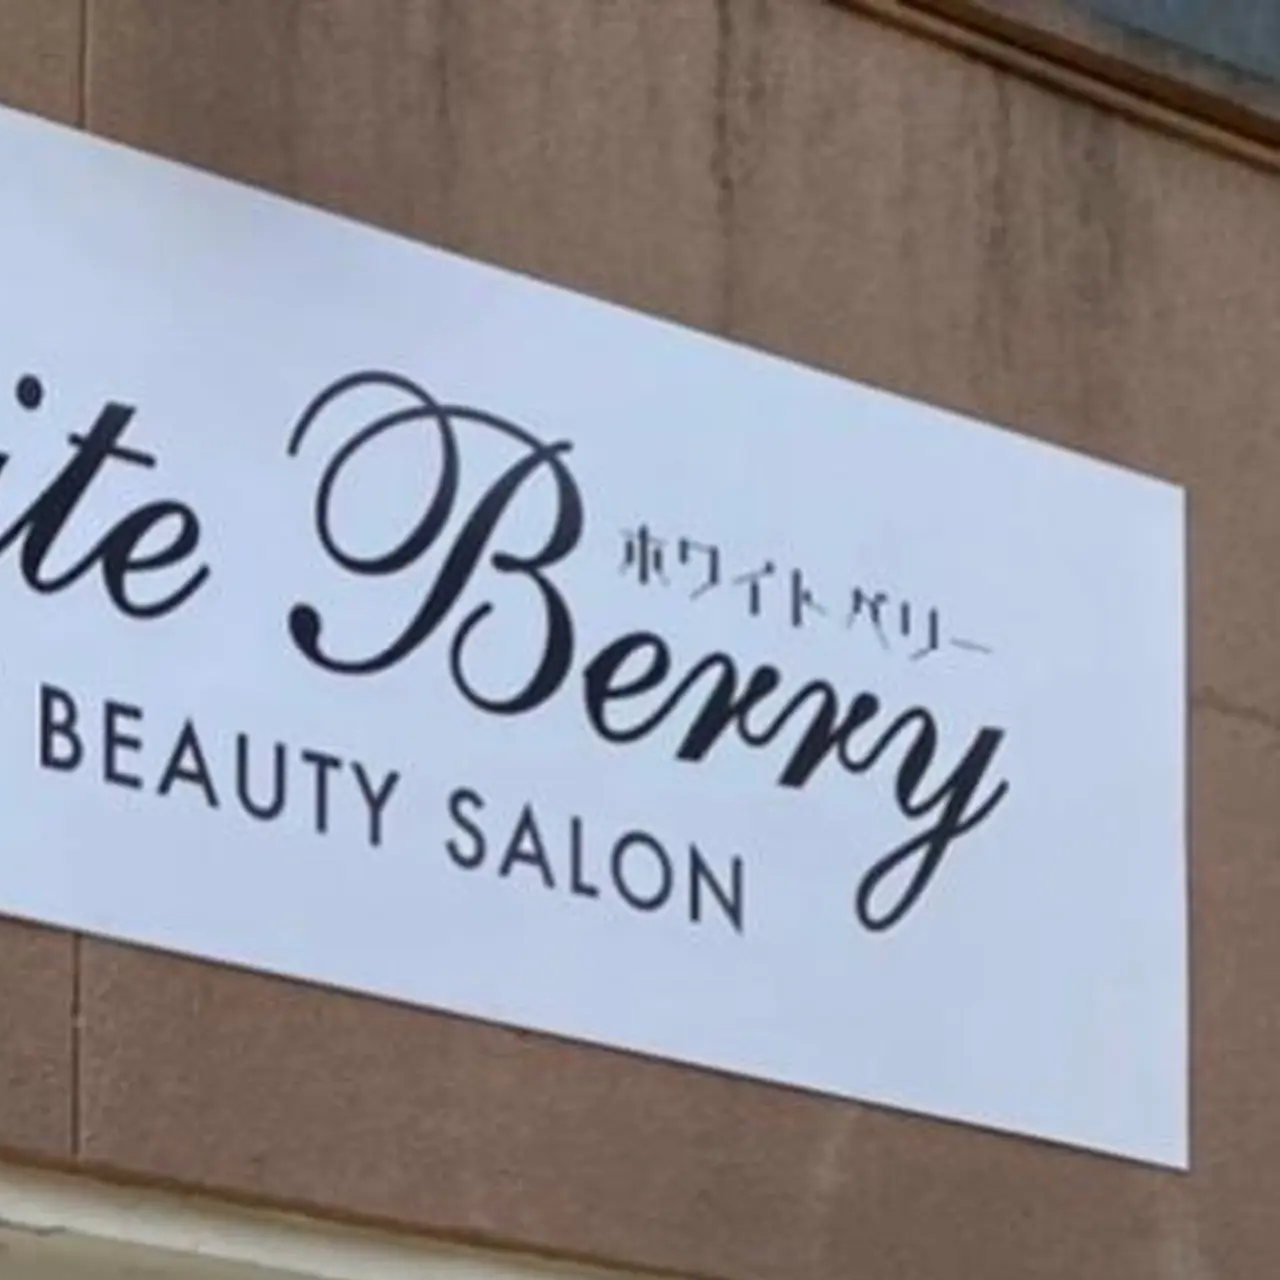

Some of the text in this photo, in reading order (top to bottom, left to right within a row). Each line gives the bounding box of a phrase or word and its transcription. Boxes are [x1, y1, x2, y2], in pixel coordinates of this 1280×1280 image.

[288, 370, 1009, 932] Berry
[618, 522, 828, 628] ホワイト
[40, 684, 400, 846] BEAUTY
[445, 787, 745, 934] SALON
